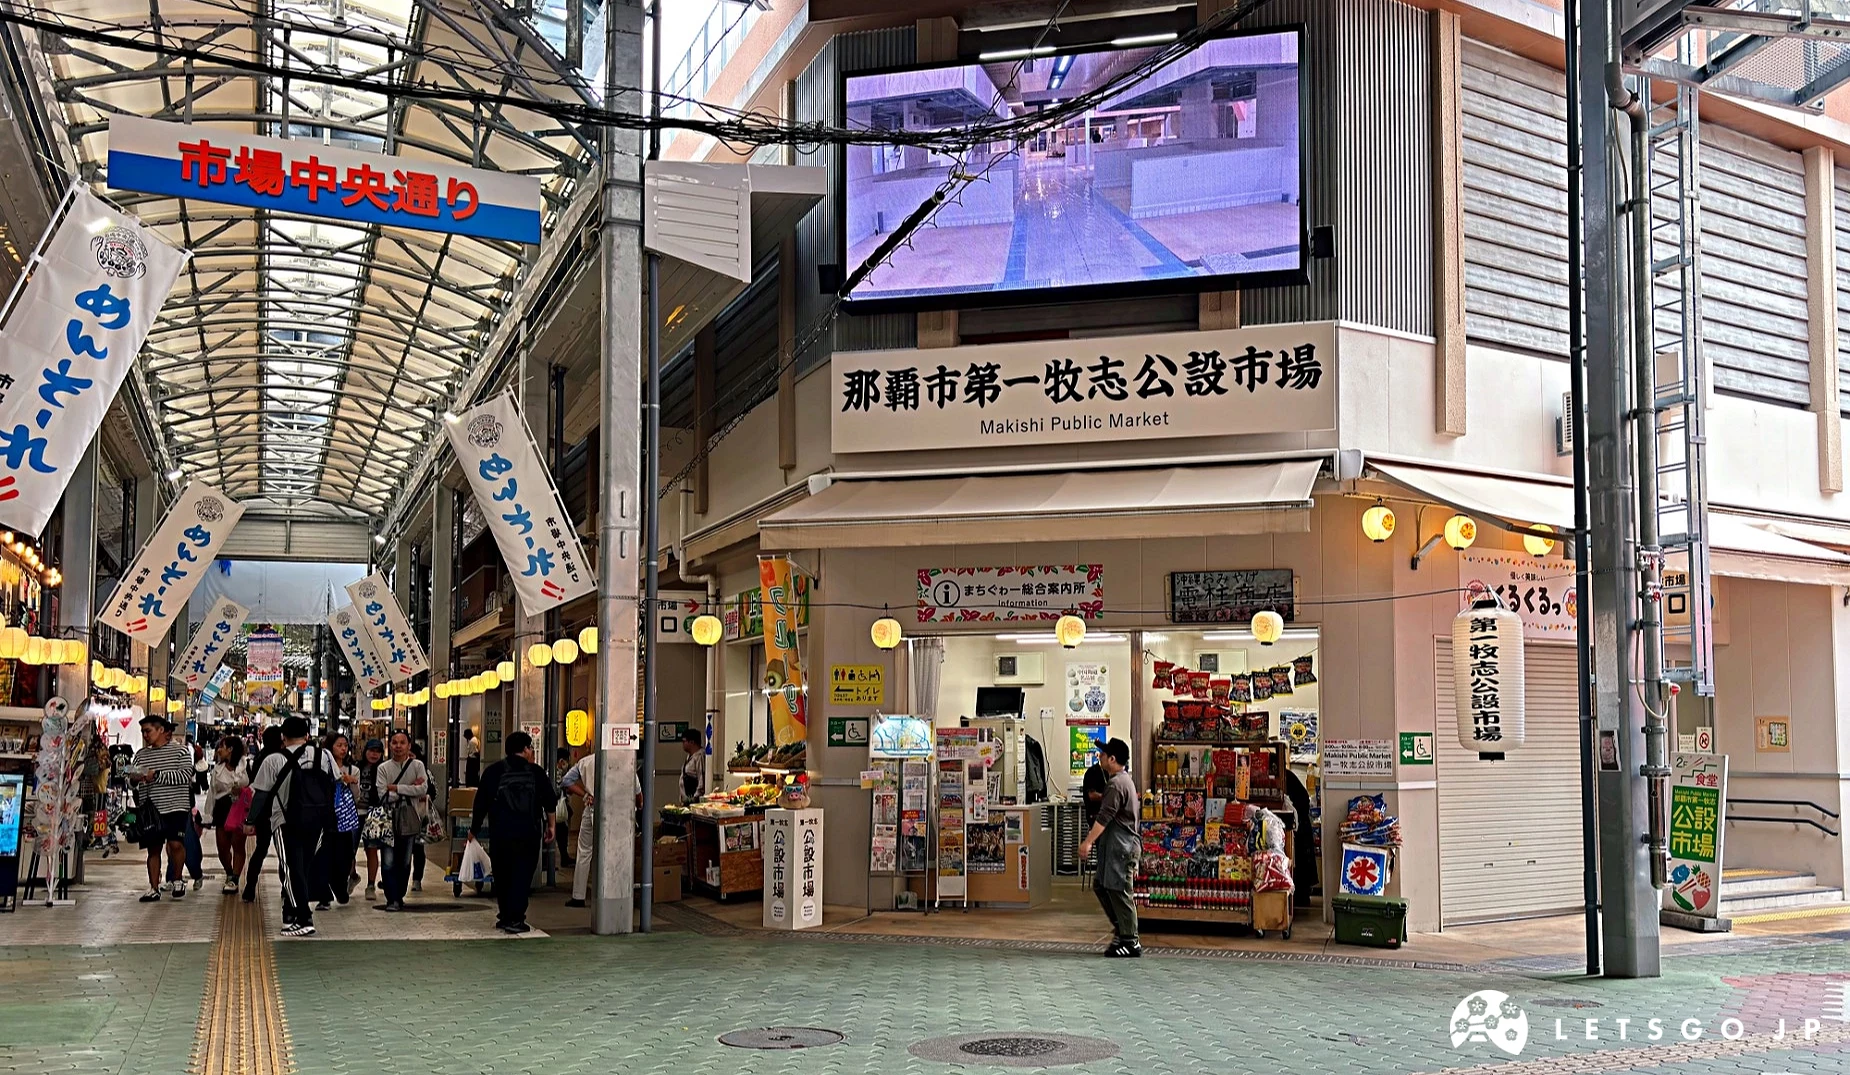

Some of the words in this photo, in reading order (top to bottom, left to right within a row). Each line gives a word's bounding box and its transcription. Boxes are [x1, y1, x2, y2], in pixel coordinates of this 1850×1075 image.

[178, 139, 479, 220] 市場中央通り
[841, 343, 1323, 413] 那覇市第一牧志公設市場
[980, 416, 1044, 435] Makishi
[1050, 413, 1103, 432] Public
[1109, 411, 1169, 429] Market
[1177, 570, 1259, 585] 沖縄おみやげ
[1509, 571, 1546, 582] 優しく美味しい
[1662, 574, 1686, 587] 市場
[998, 599, 1048, 607] Information
[1180, 582, 1286, 610] 電柱商店
[856, 687, 881, 695] トイレ
[1469, 617, 1503, 742] 第一牧志公設市場
[1324, 760, 1392, 770] 第一牧志公設市場
[1349, 752, 1369, 760] Public
[1675, 756, 1688, 768] 2F
[1695, 773, 1718, 787] 食堂
[1672, 804, 1717, 832] 公設
[1672, 831, 1715, 858] 市場
[772, 829, 786, 899] 公設市場
[802, 829, 815, 898] 公設市場
[1350, 858, 1378, 887] 氷
